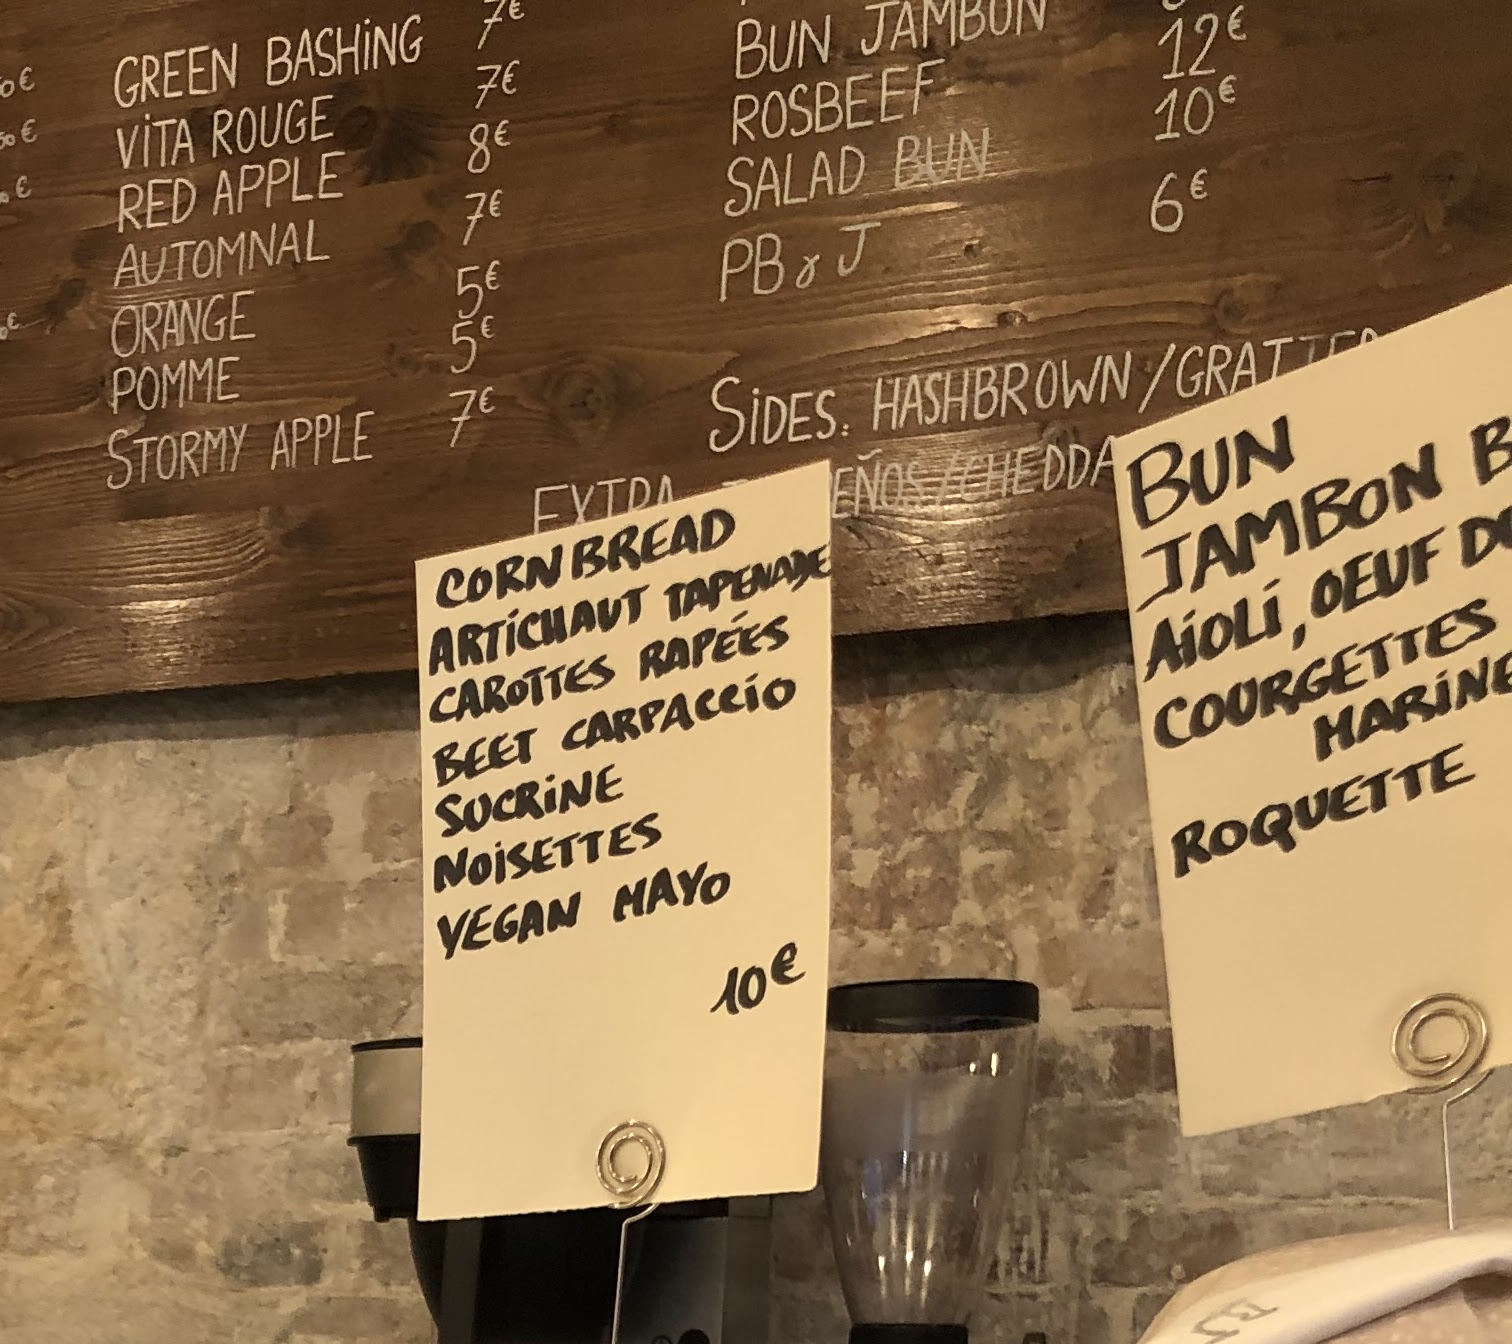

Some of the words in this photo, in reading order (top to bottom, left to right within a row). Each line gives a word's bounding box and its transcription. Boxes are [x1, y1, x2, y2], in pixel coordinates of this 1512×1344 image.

[113, 42, 238, 108] GREEN
[475, 60, 520, 109] 7€
[731, 58, 945, 145] ROSBEEF
[1157, 4, 1247, 79] 12€
[735, 15, 830, 80] BUN
[212, 95, 335, 158] ROUGE
[467, 120, 511, 174] 8€
[724, 144, 866, 218] SALAD
[894, 127, 989, 190] BUN
[1154, 75, 1237, 141] 10€
[118, 178, 197, 233] RED
[213, 151, 346, 217] APPLE
[463, 189, 503, 246] 7€
[720, 232, 785, 302] PB
[837, 222, 881, 277] J
[1150, 168, 1208, 233] 6€
[114, 219, 330, 288] AUTOMNAL
[457, 260, 501, 320] 5€
[111, 290, 256, 358] ORANGE
[450, 315, 495, 374] 5€
[112, 356, 240, 415] POMME
[449, 387, 495, 448] 7€
[107, 423, 248, 490] STORMY
[271, 410, 375, 470] APPLE
[1126, 415, 1295, 530] BUN
[1136, 442, 1442, 613] JAMBON
[1311, 526, 1446, 618] OEUF
[664, 543, 831, 622] TAPENADE
[429, 654, 615, 723] CAROTTES
[1154, 598, 1497, 749] COURGETTES
[432, 727, 539, 787] BEET
[1171, 743, 1477, 879] ROQUETTE
[437, 891, 581, 960] VEGAN
[613, 861, 731, 923] MAYO
[710, 942, 806, 1016] 10€
